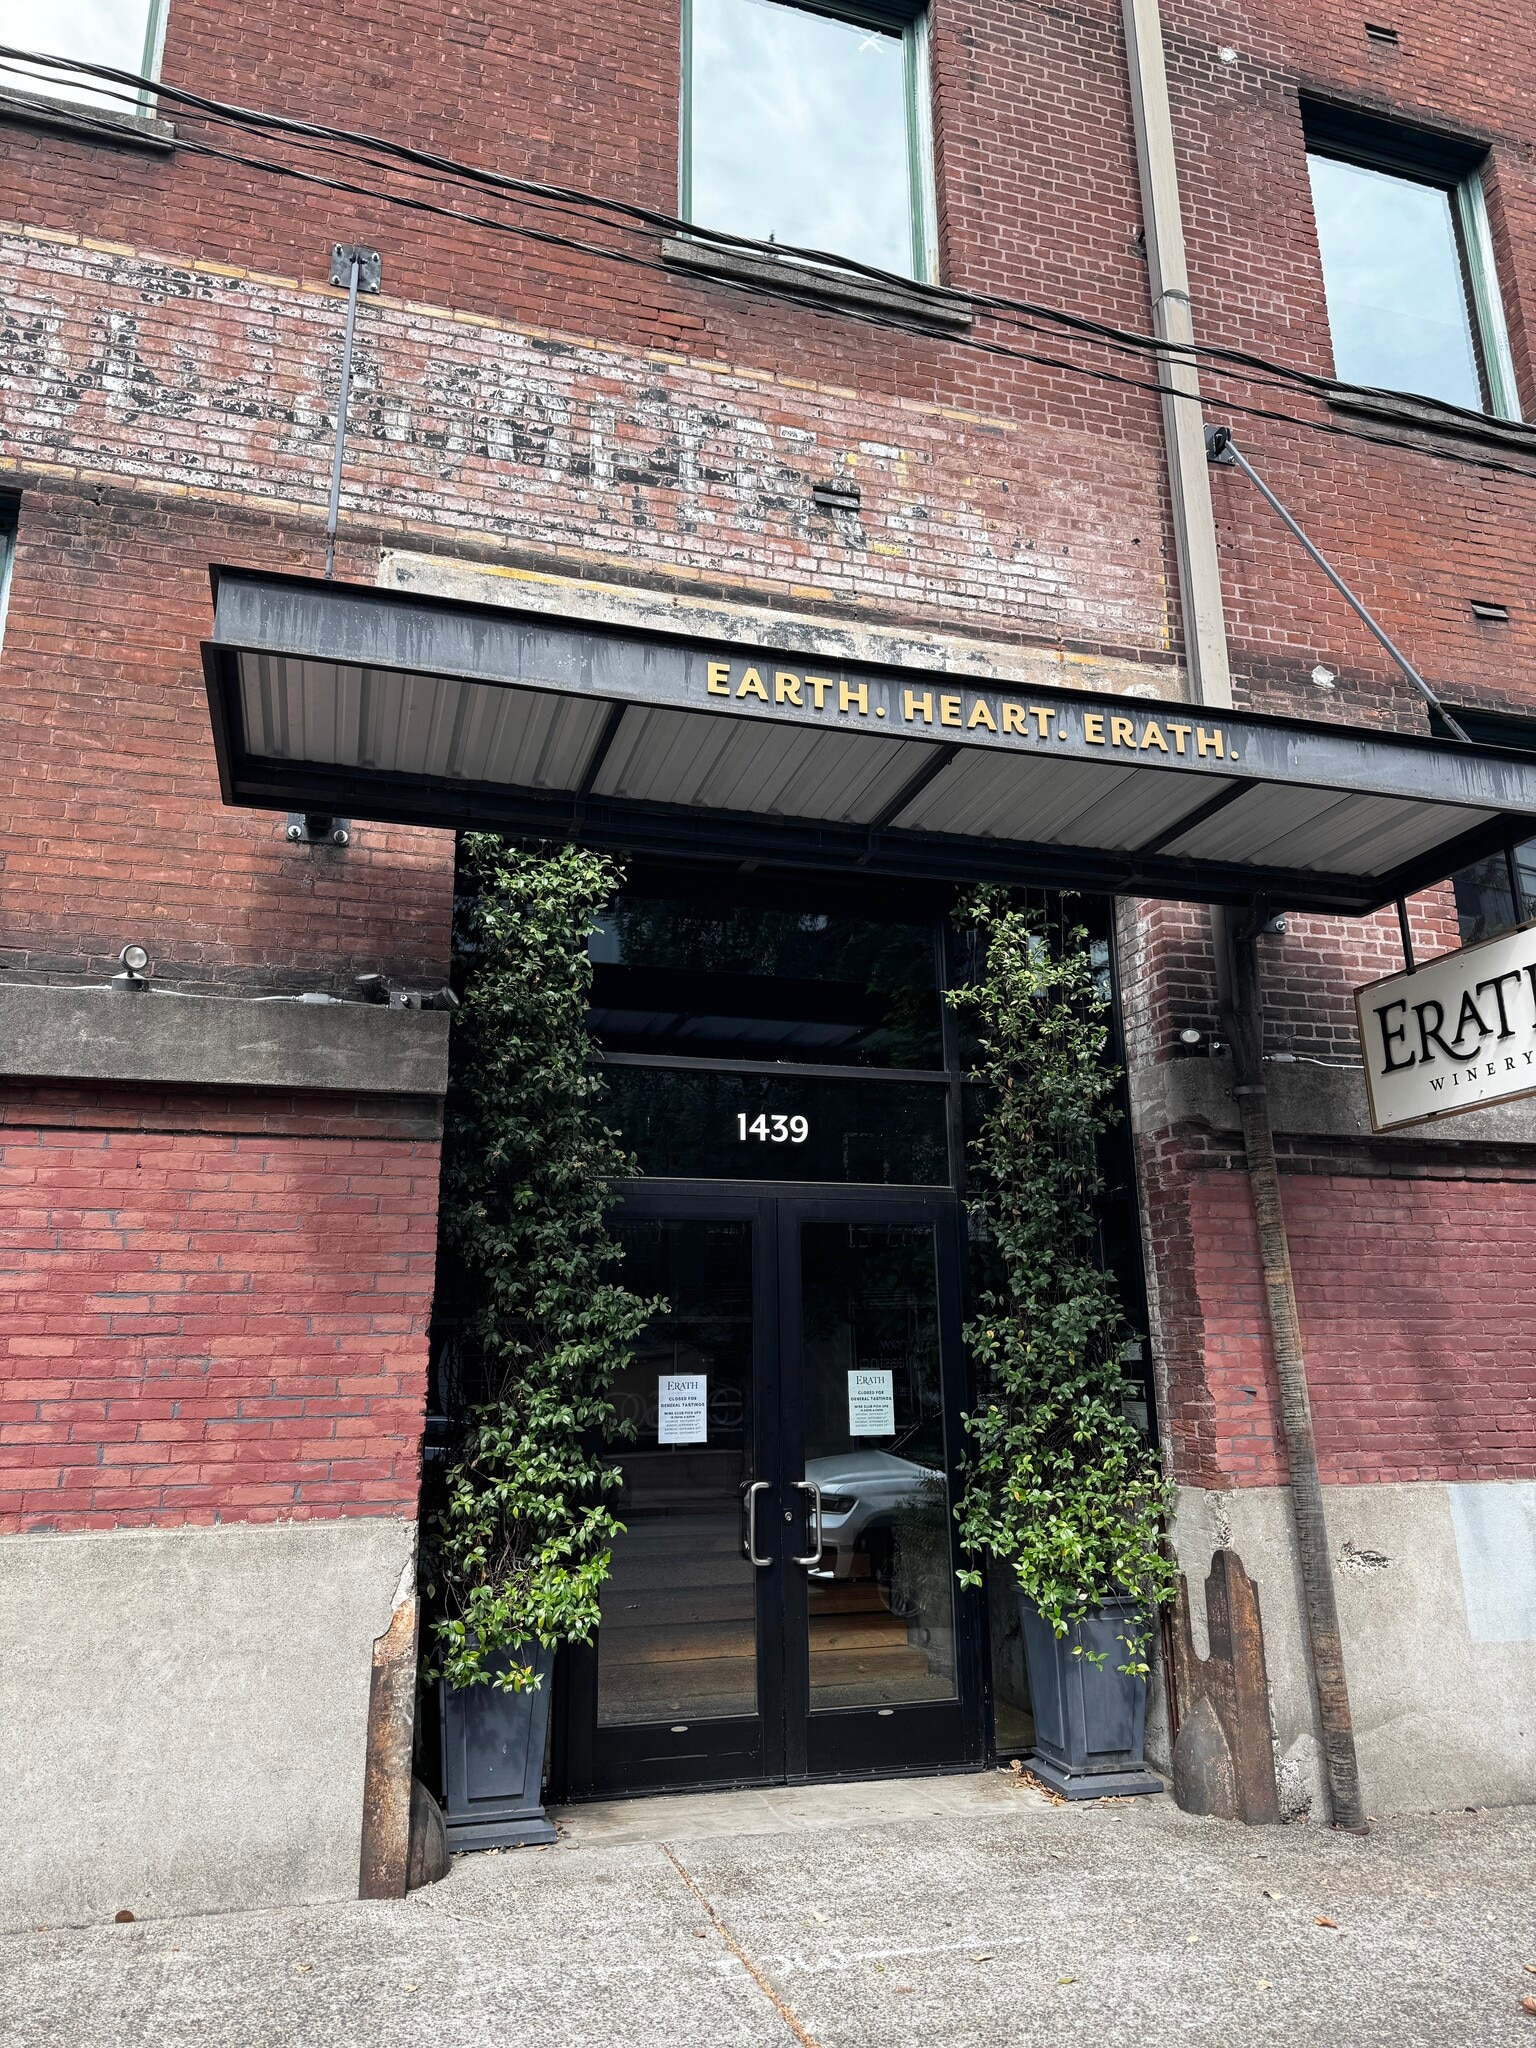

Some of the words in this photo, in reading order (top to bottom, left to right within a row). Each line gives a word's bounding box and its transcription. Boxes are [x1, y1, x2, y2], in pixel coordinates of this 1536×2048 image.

[706, 661, 886, 717] EARTH.
[903, 689, 1068, 740] HEART.
[1082, 712, 1240, 760] ERATH.
[1429, 1050, 1533, 1092] WINERY
[737, 1112, 809, 1143] 1439
[667, 1381, 698, 1391] ERATH
[856, 1375, 885, 1385] ERATH
